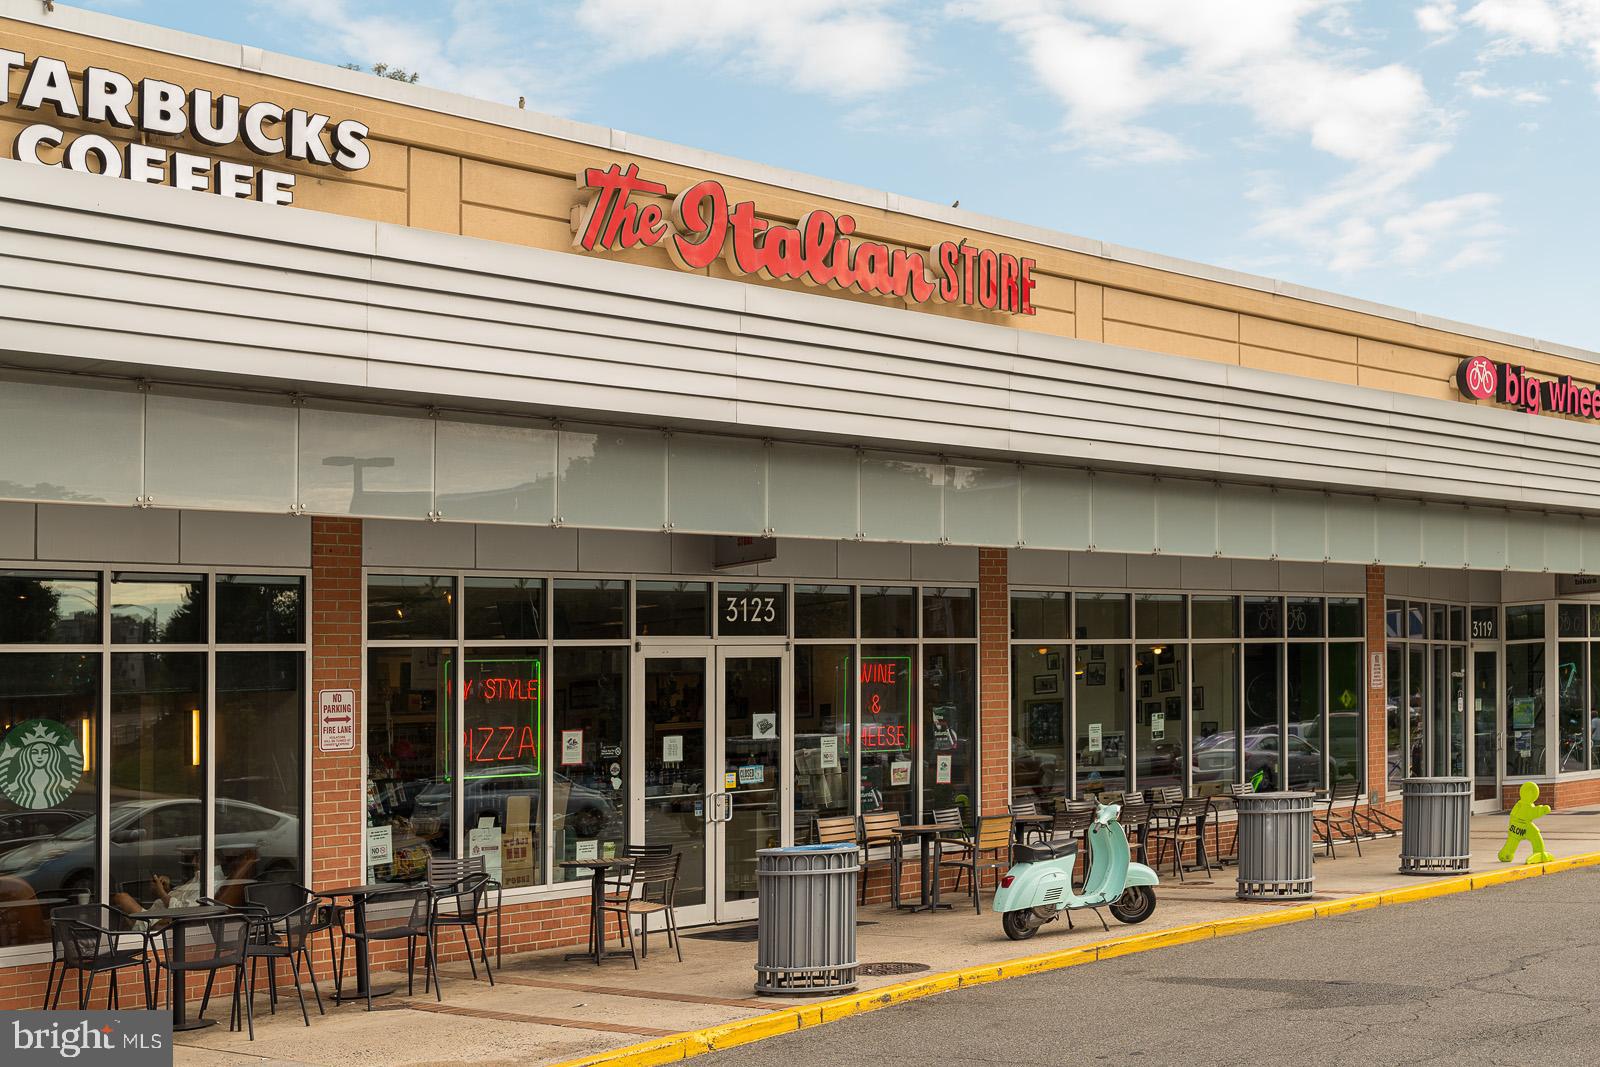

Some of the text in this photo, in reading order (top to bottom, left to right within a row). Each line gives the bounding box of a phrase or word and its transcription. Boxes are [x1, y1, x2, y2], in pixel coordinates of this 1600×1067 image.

[574, 161, 1037, 316] The Italian STORE
[1505, 362, 1540, 416] big
[726, 597, 776, 622] 3123
[1472, 620, 1493, 638] 3119
[860, 663, 896, 684] WINE
[332, 693, 342, 703] NO
[484, 678, 538, 700] STYLE
[323, 704, 352, 714] PARKING
[322, 725, 352, 734] FIRE LANE
[371, 847, 380, 855] NO
